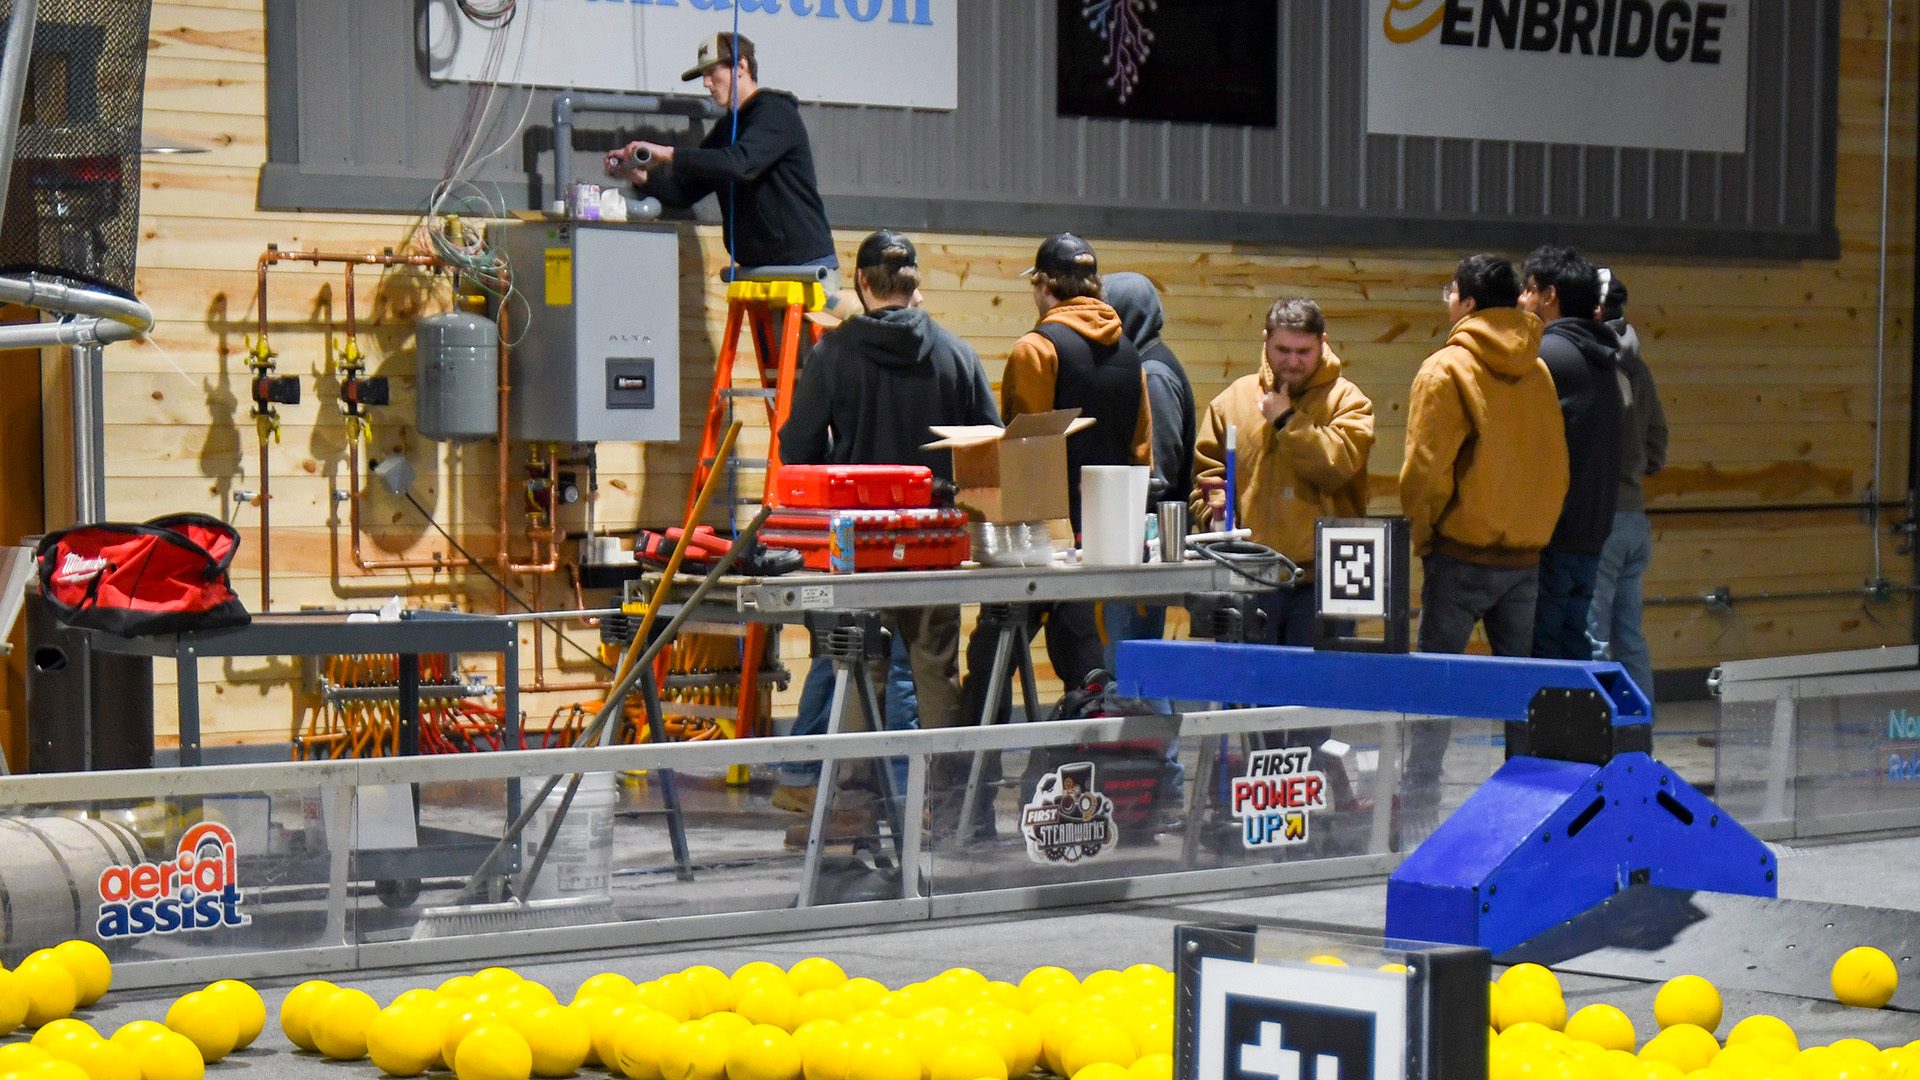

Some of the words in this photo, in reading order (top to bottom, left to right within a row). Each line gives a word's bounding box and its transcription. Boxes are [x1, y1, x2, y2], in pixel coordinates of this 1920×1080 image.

[1440, 0, 1727, 64] ENBRIDGE
[1251, 752, 1308, 777] FIRST
[1235, 776, 1322, 812] POWER
[1027, 808, 1058, 823] FIRST
[1247, 812, 1283, 844] UP
[100, 844, 235, 902] aerial
[99, 884, 242, 937] assist
